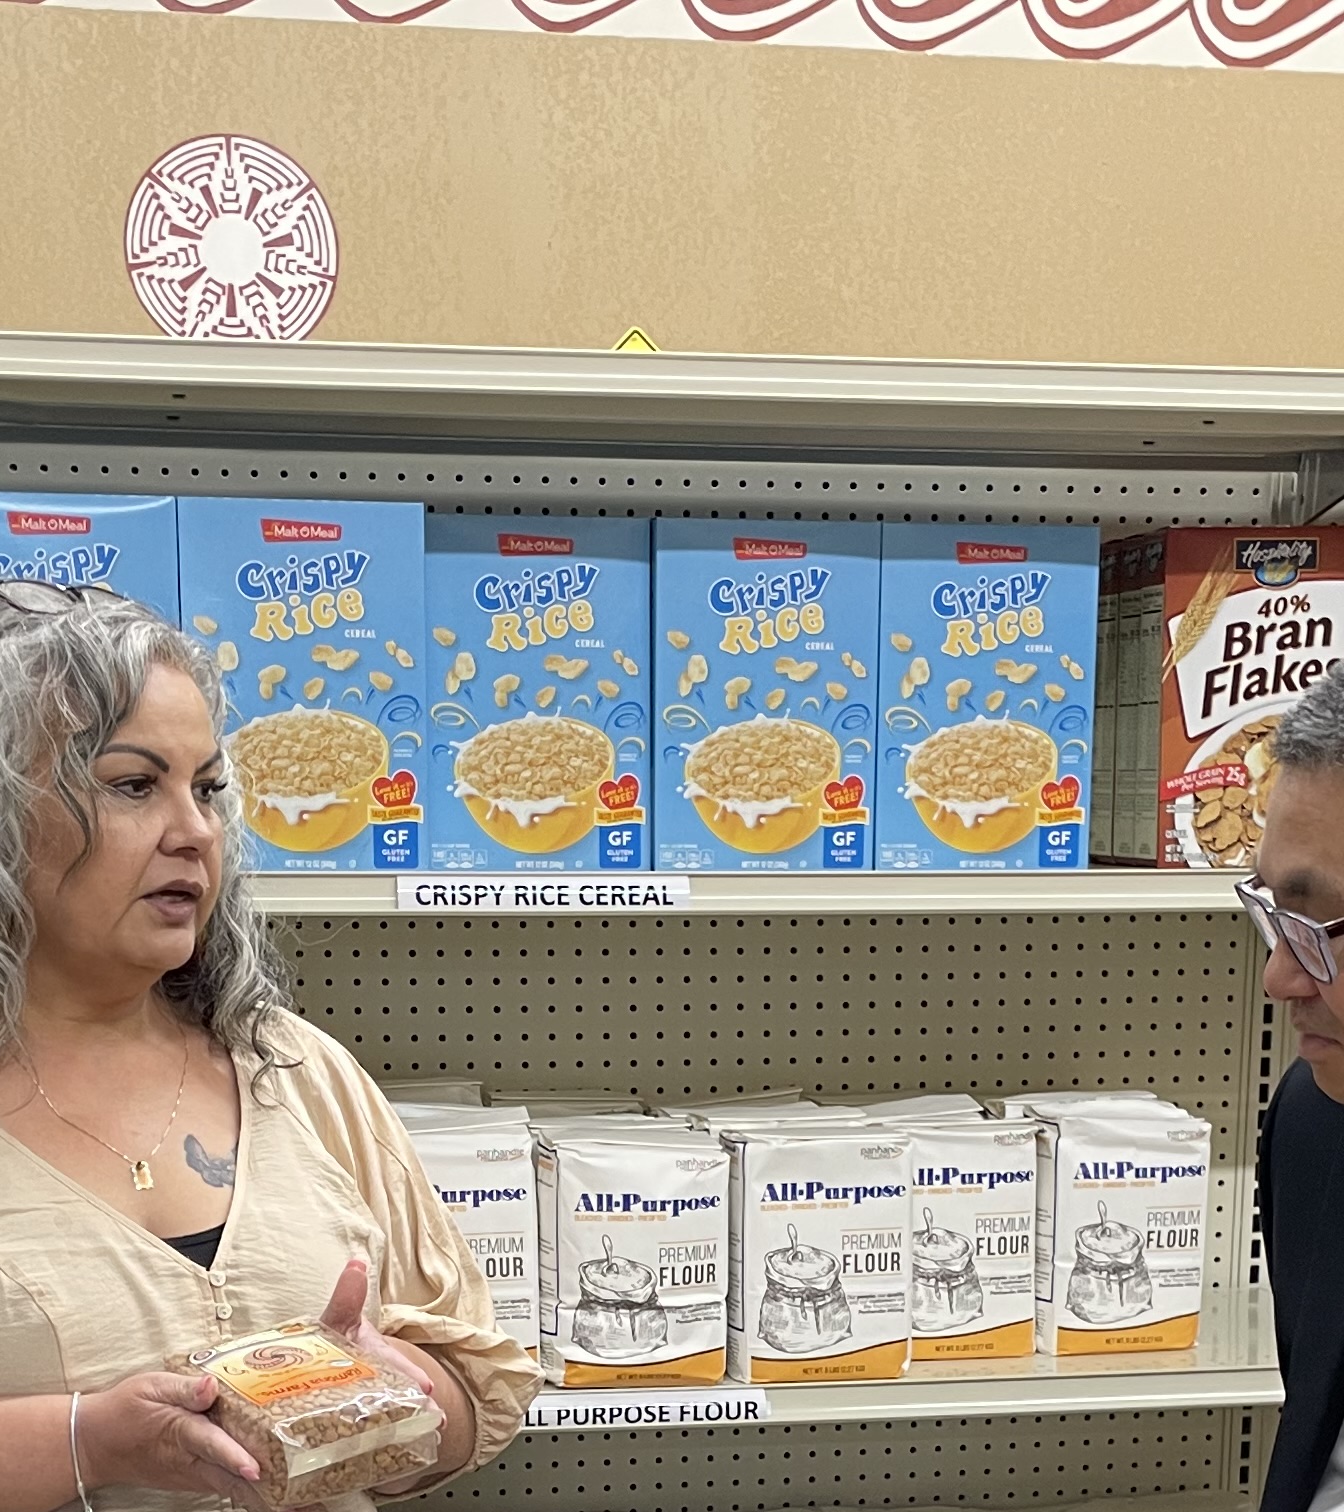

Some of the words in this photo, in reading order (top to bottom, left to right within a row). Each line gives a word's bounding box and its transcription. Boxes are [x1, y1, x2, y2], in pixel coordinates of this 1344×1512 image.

[236, 550, 370, 600] Crispy
[474, 563, 600, 613] Crispy
[708, 567, 831, 616] Crispy
[931, 571, 1051, 619] Crispy
[250, 588, 364, 642] Rice
[1258, 594, 1311, 618] 40%
[344, 629, 376, 639] CEREAL
[486, 600, 594, 652] Rice
[719, 602, 825, 655] Rice
[941, 606, 1044, 657] Rice
[575, 639, 604, 648] CEREAL
[1025, 645, 1053, 653] CEREAL
[1223, 615, 1333, 662] Bran
[1201, 654, 1341, 720] Flake
[383, 830, 408, 845] GF
[608, 831, 632, 846] GF
[833, 831, 856, 846] GF
[1047, 831, 1071, 846] GF
[416, 885, 505, 906] CRISPY
[515, 884, 569, 905] RICE
[578, 884, 674, 906] CEREAL
[1074, 1162, 1206, 1184] All-Purpose
[760, 1181, 906, 1205] All-Purpose
[574, 1193, 720, 1218] All-Purpose
[975, 1215, 1030, 1234] PREMIUM
[1147, 1210, 1200, 1228] PREMIUM
[841, 1232, 902, 1251] PREMIUM
[976, 1235, 1029, 1256] FLOUR
[1147, 1229, 1198, 1250] FLOUR
[659, 1242, 717, 1262] PREMIUM
[843, 1253, 901, 1274] FLOUR
[659, 1264, 716, 1287] FLOUR
[525, 1409, 548, 1426] LL
[556, 1404, 670, 1425] PURPOSE
[679, 1400, 758, 1421] FLOUR
